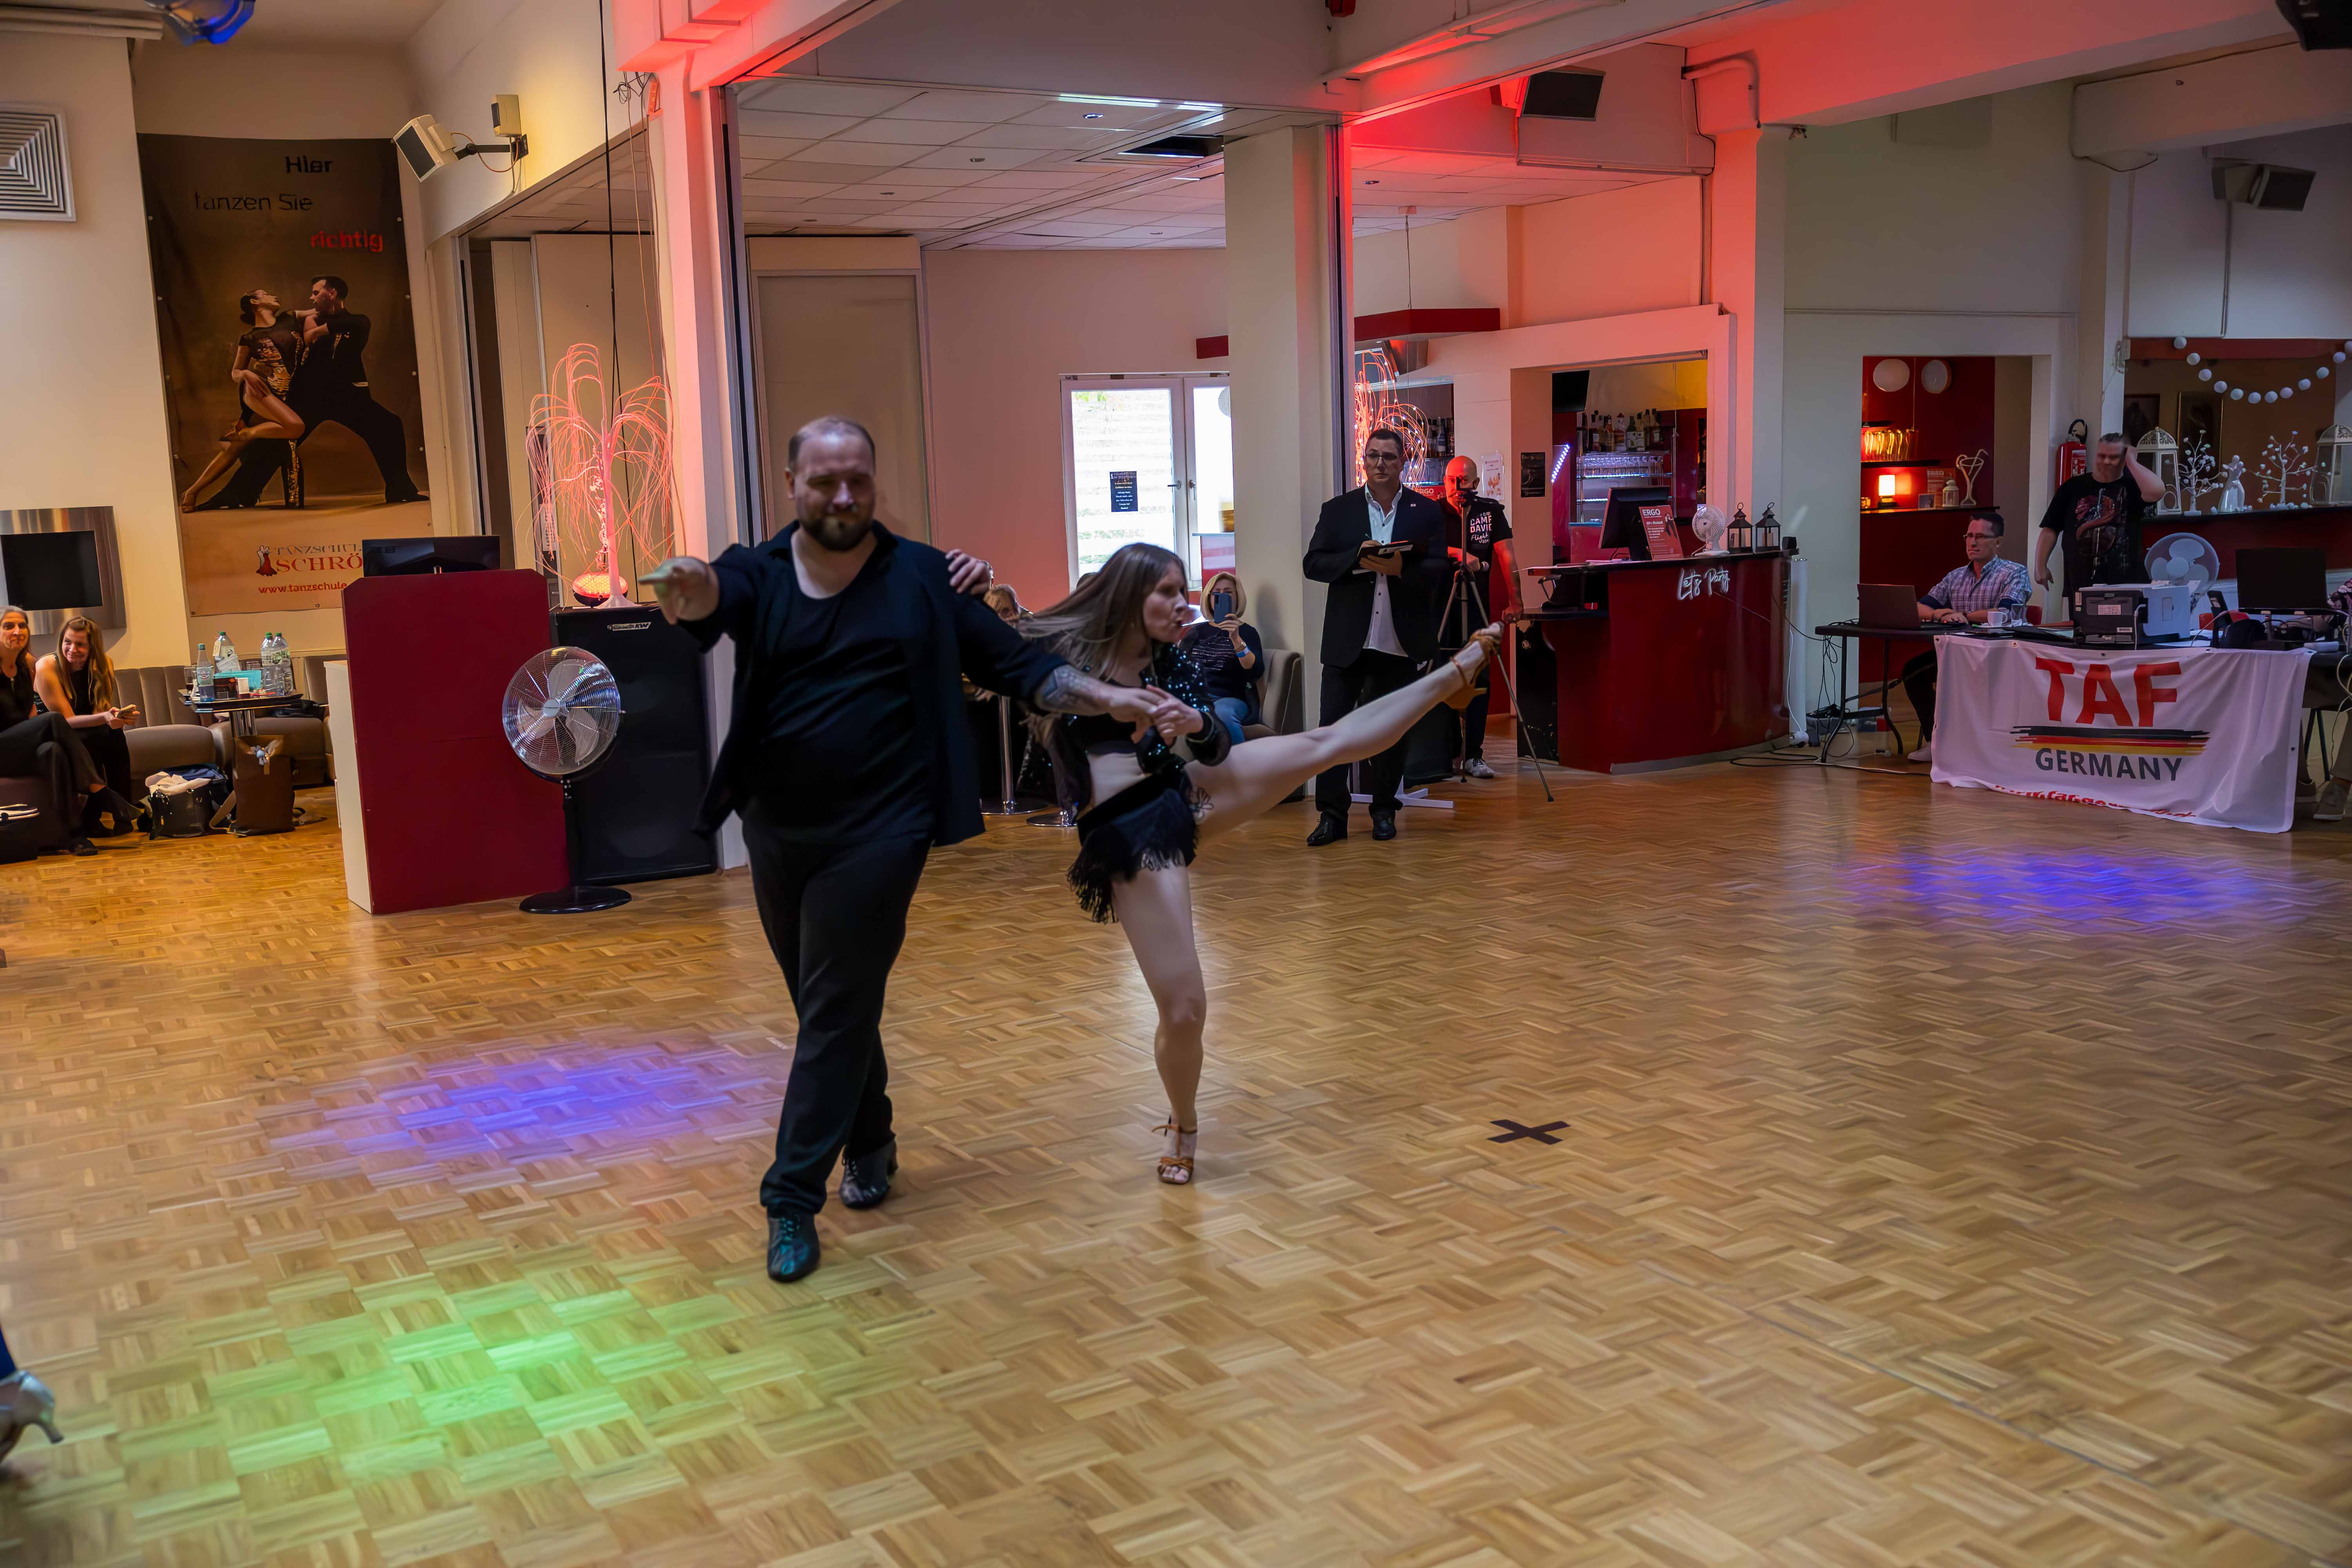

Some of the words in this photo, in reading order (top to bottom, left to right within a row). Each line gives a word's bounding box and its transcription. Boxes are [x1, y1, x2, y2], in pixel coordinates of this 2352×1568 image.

[285, 155, 334, 174] Hier
[194, 192, 272, 211] tanzen
[278, 194, 313, 211] Sie
[310, 230, 383, 252] richtig
[1471, 532, 1488, 543] Flight
[274, 544, 362, 555] TANZSCHU
[1704, 566, 1731, 596] Party
[2035, 656, 2182, 727] TAF
[2035, 748, 2182, 781] GERMANY
